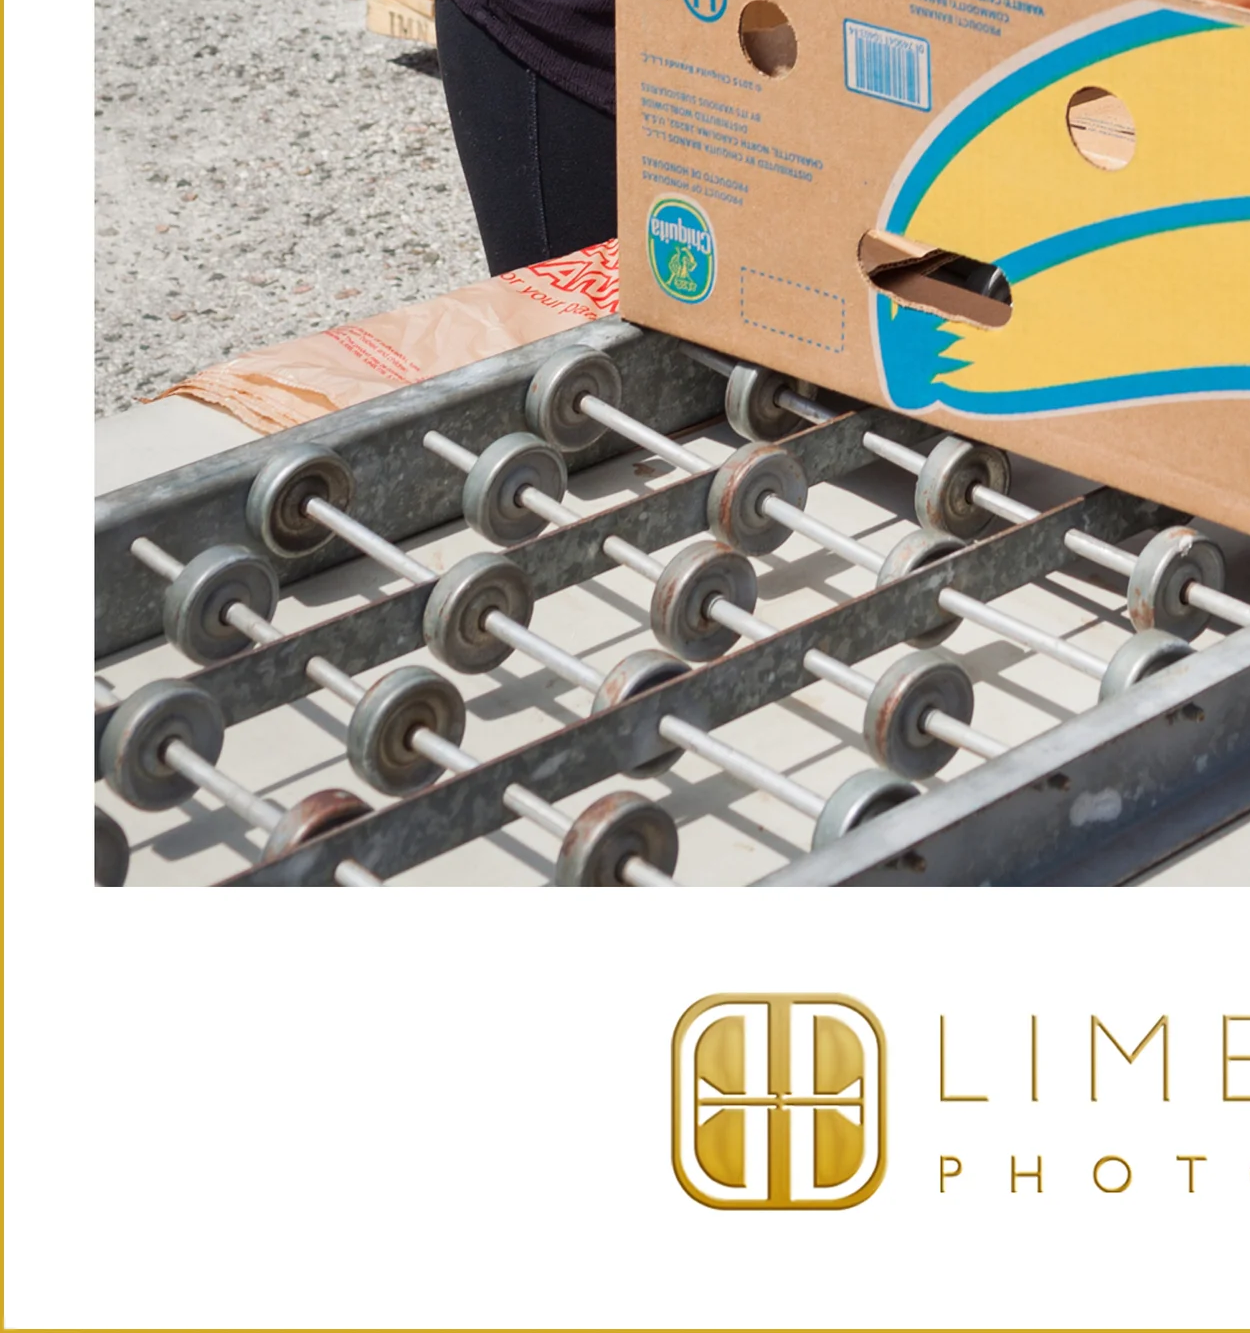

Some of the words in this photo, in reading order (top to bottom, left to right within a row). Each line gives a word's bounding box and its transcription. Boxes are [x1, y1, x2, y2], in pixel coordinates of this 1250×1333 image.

[909, 4, 953, 24] BANANAS
[664, 58, 694, 74] Brands
[696, 67, 731, 84] Chiquita
[640, 82, 696, 105] SUBSIDIARIES
[640, 97, 692, 118] WORLDWIDE
[698, 97, 734, 115] VARIOUS
[735, 108, 748, 118] ITS
[694, 111, 748, 134] DISTRIBUTED
[750, 112, 761, 122] BY
[668, 134, 702, 151] BRANDS
[697, 127, 739, 146] CAROLINA
[704, 143, 743, 161] CHIQUITA
[740, 140, 769, 154] NORTH
[641, 156, 689, 176] HONDURAS
[745, 156, 756, 165] BY
[642, 170, 689, 190] HONDURAS
[691, 169, 701, 179] DE
[758, 159, 812, 182] DISTRIBUTED
[703, 172, 749, 193] PRODUCTO
[703, 186, 744, 206] PRODUCT
[651, 218, 711, 254] Chiquita
[500, 272, 525, 284] or
[516, 286, 566, 308] your
